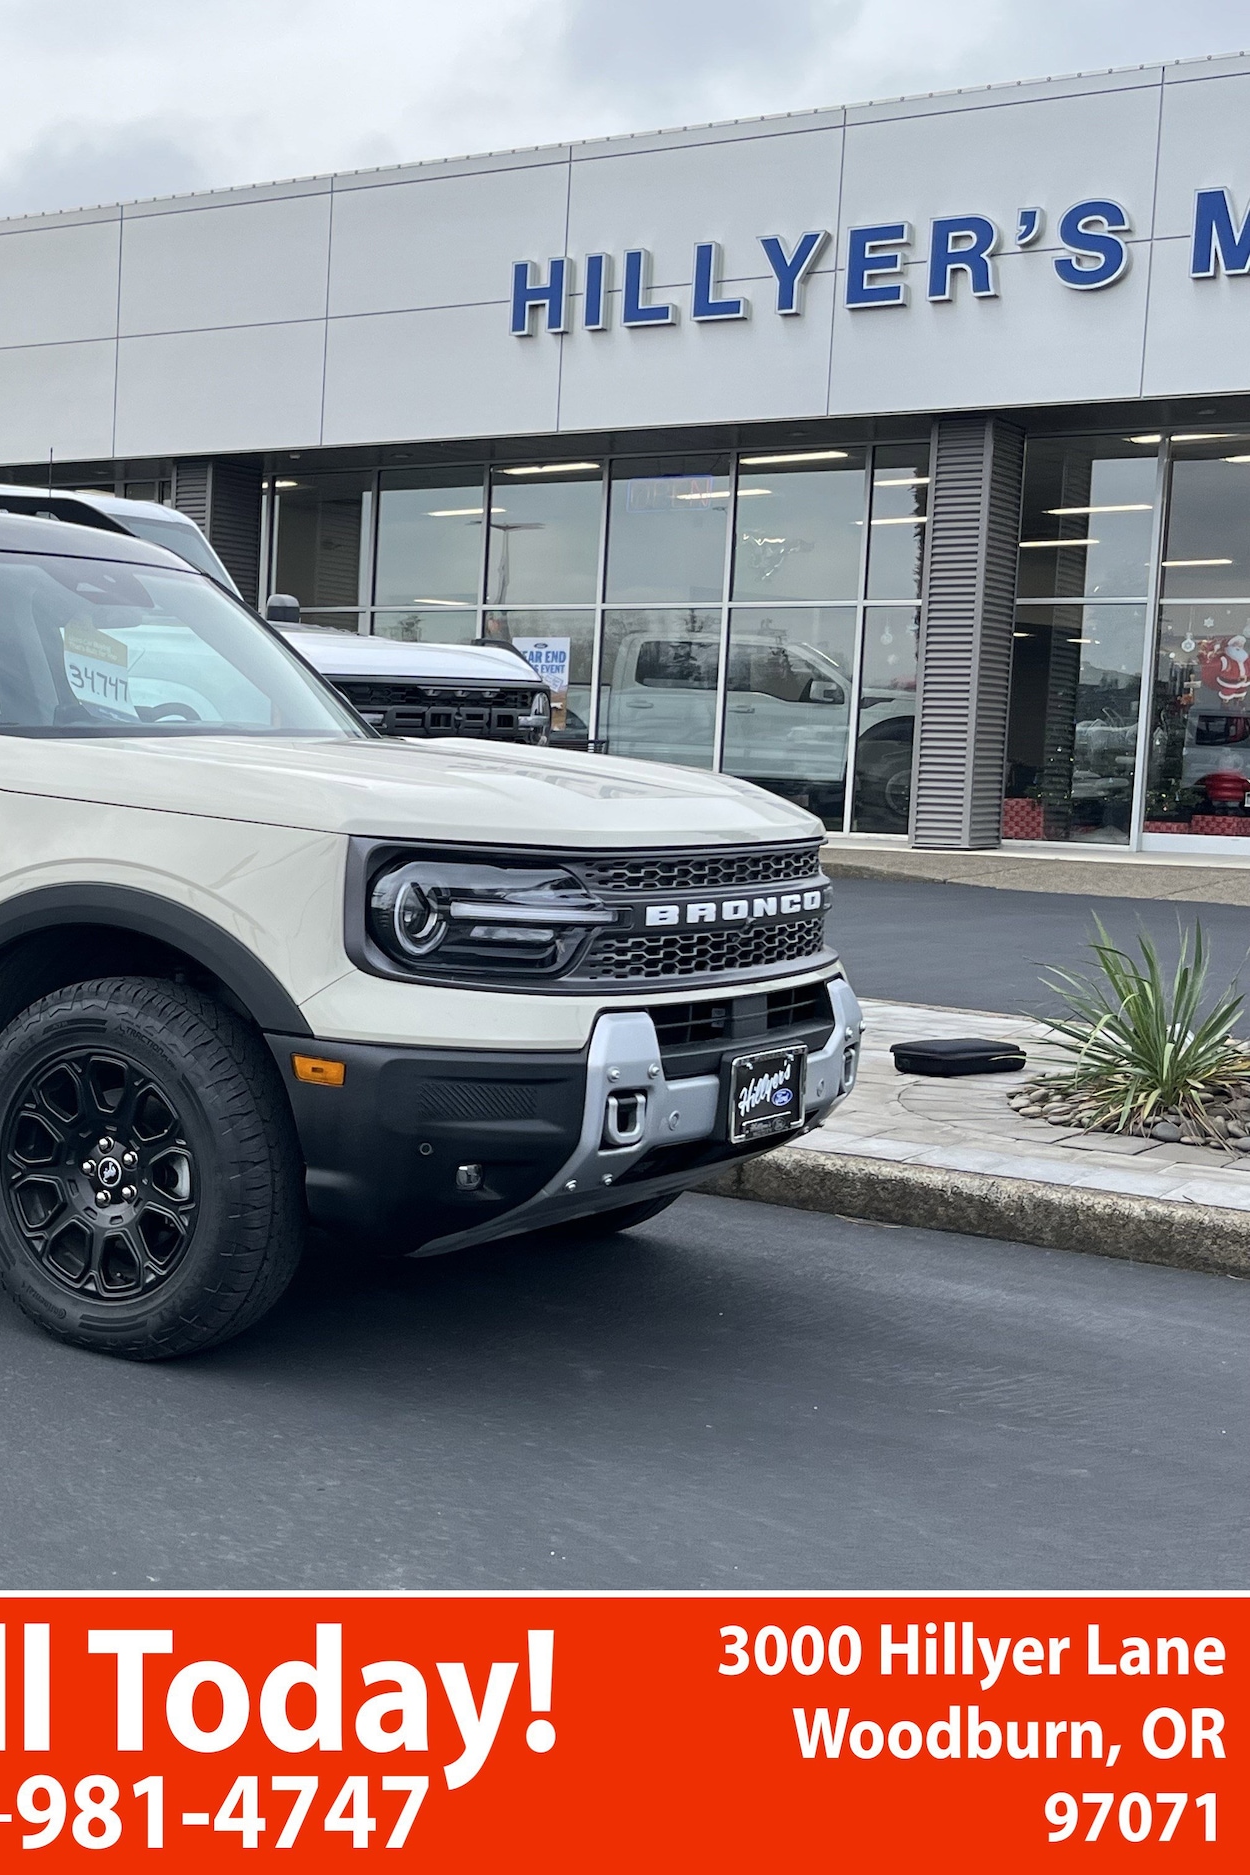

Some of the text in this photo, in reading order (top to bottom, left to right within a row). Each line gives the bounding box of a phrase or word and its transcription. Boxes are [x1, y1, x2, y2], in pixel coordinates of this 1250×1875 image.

[510, 198, 1132, 334] HILLYER'S
[521, 650, 567, 664] EAR END
[540, 664, 566, 674] EVENT
[645, 890, 822, 927] BRONCO
